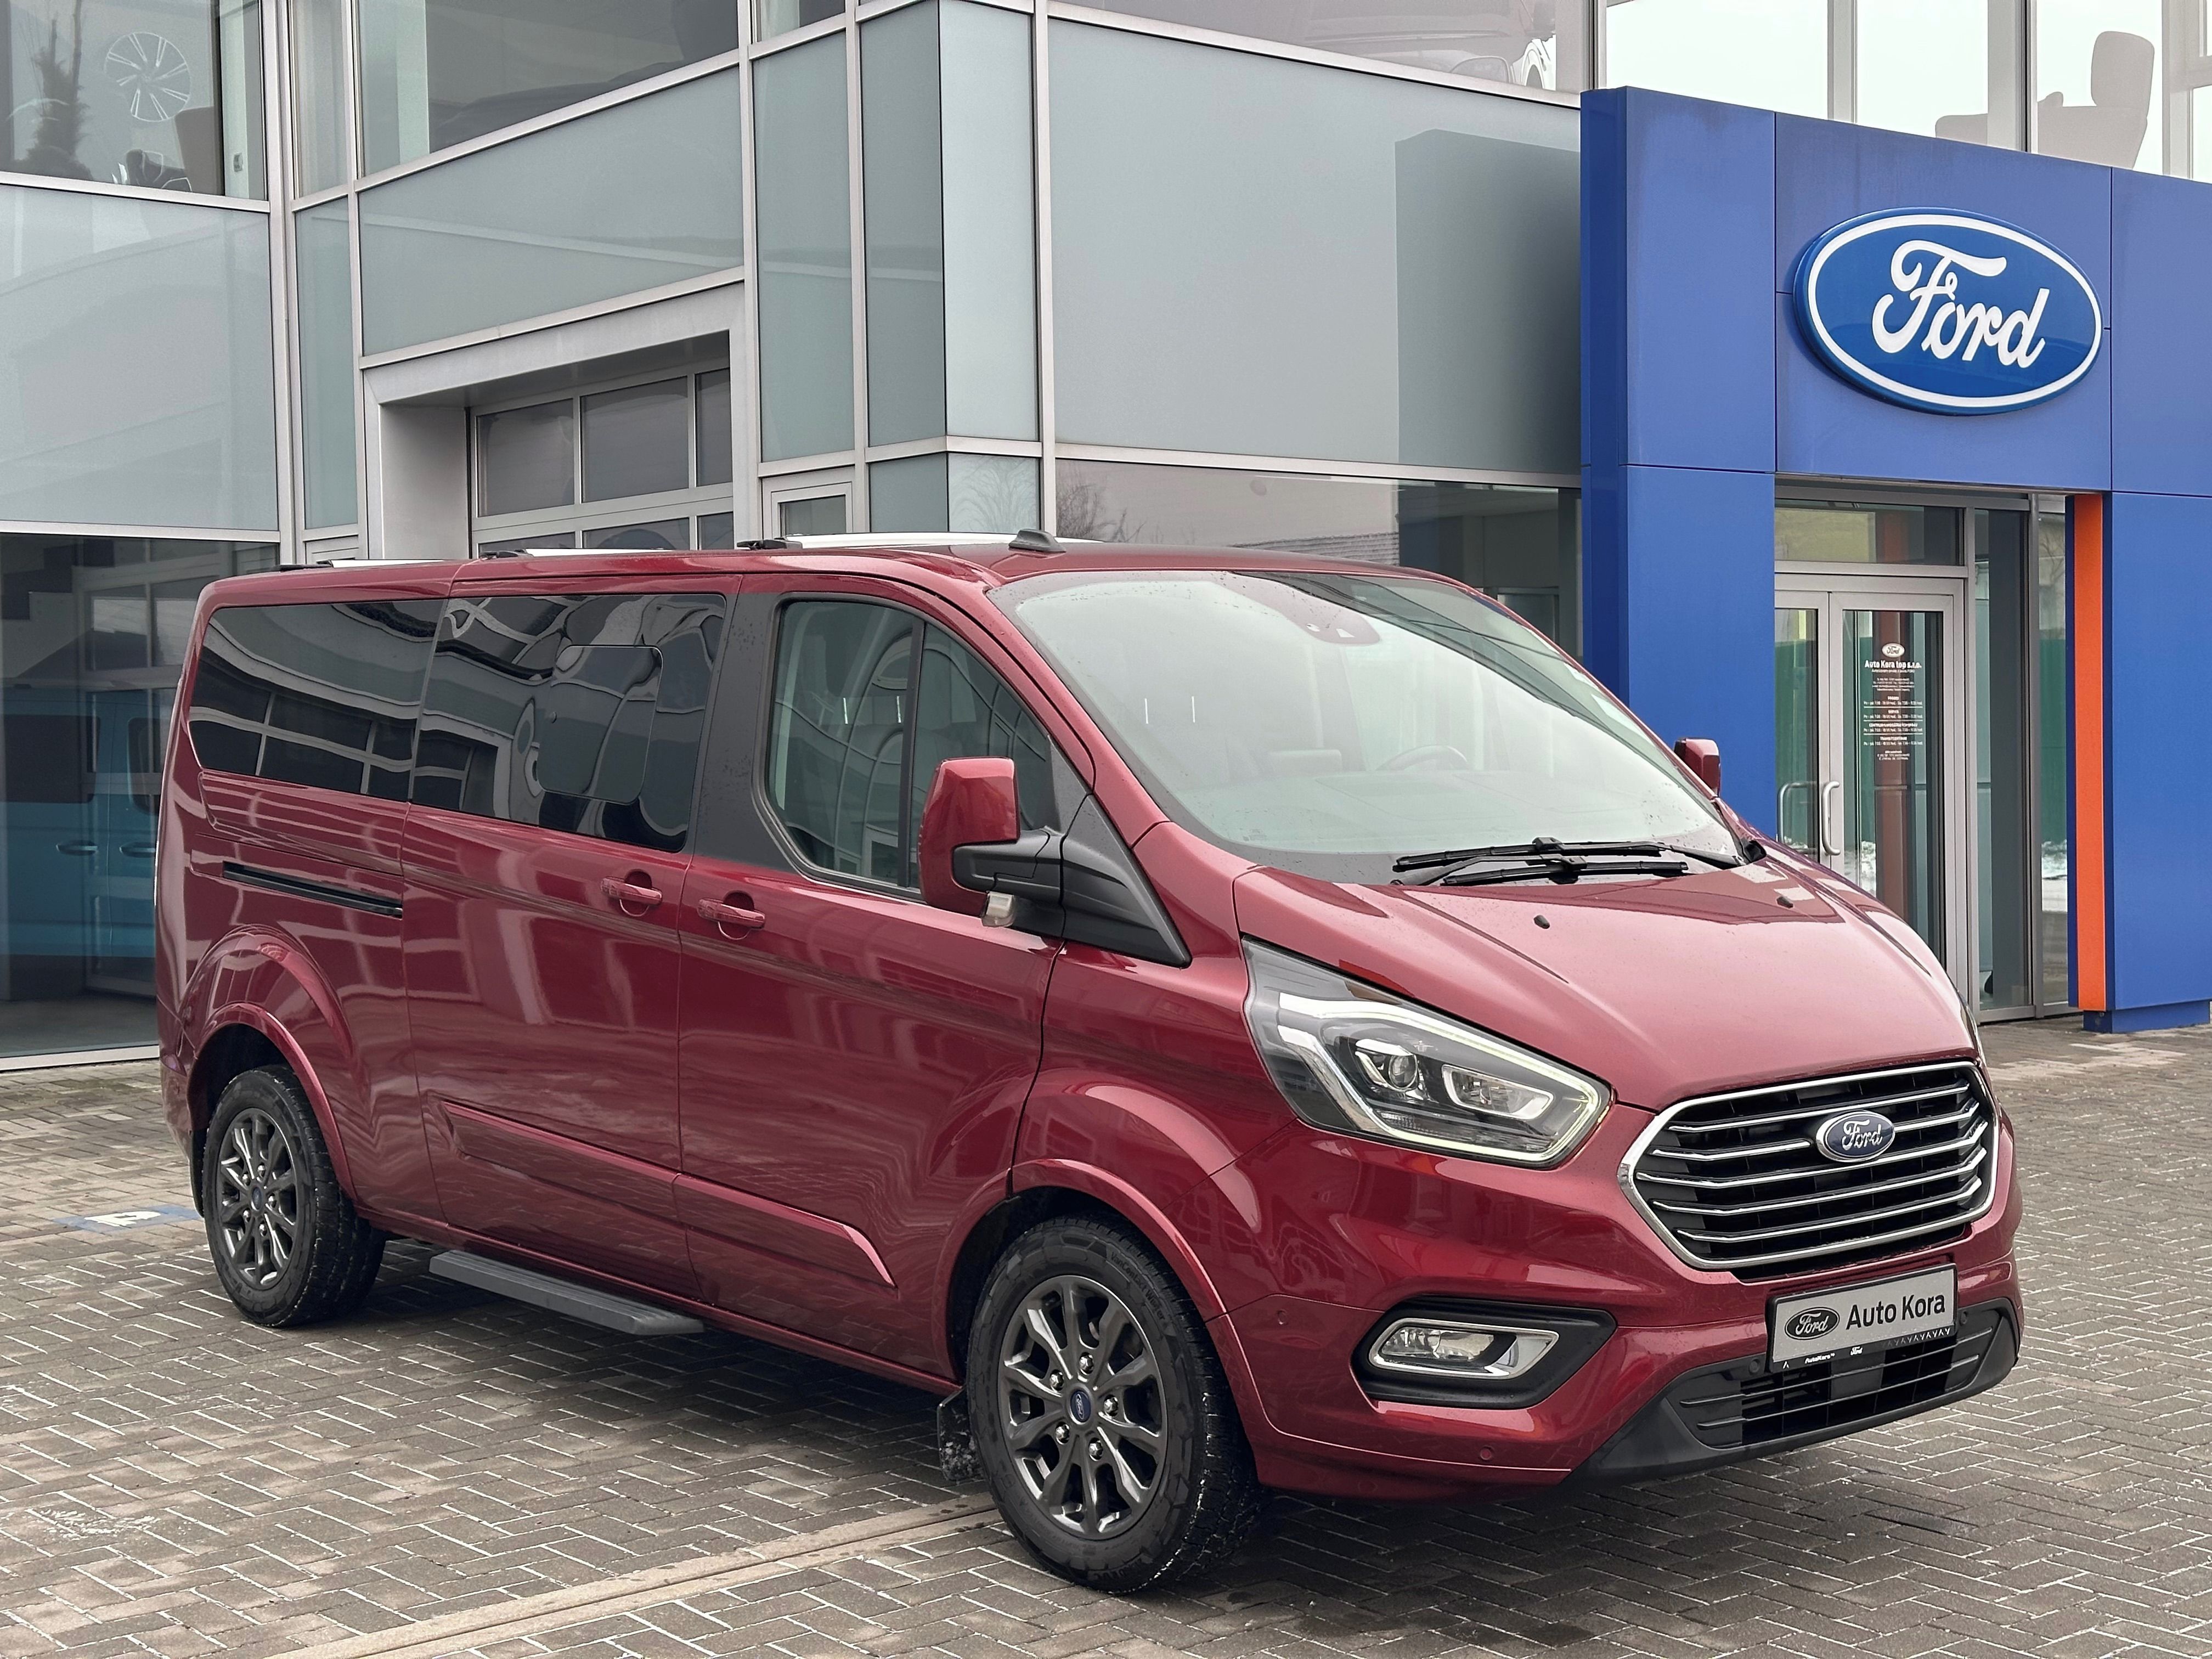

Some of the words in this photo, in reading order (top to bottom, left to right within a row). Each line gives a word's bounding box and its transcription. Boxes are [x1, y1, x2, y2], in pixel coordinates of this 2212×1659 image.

[1872, 239, 2049, 368] Ford
[1865, 660, 1880, 668] Auto
[1881, 660, 1895, 668] Kora
[1841, 1119, 1883, 1150] Ford
[1795, 1312, 1829, 1335] Ford
[1846, 1301, 1897, 1330] Auto
[1901, 1294, 1946, 1321] Kora
